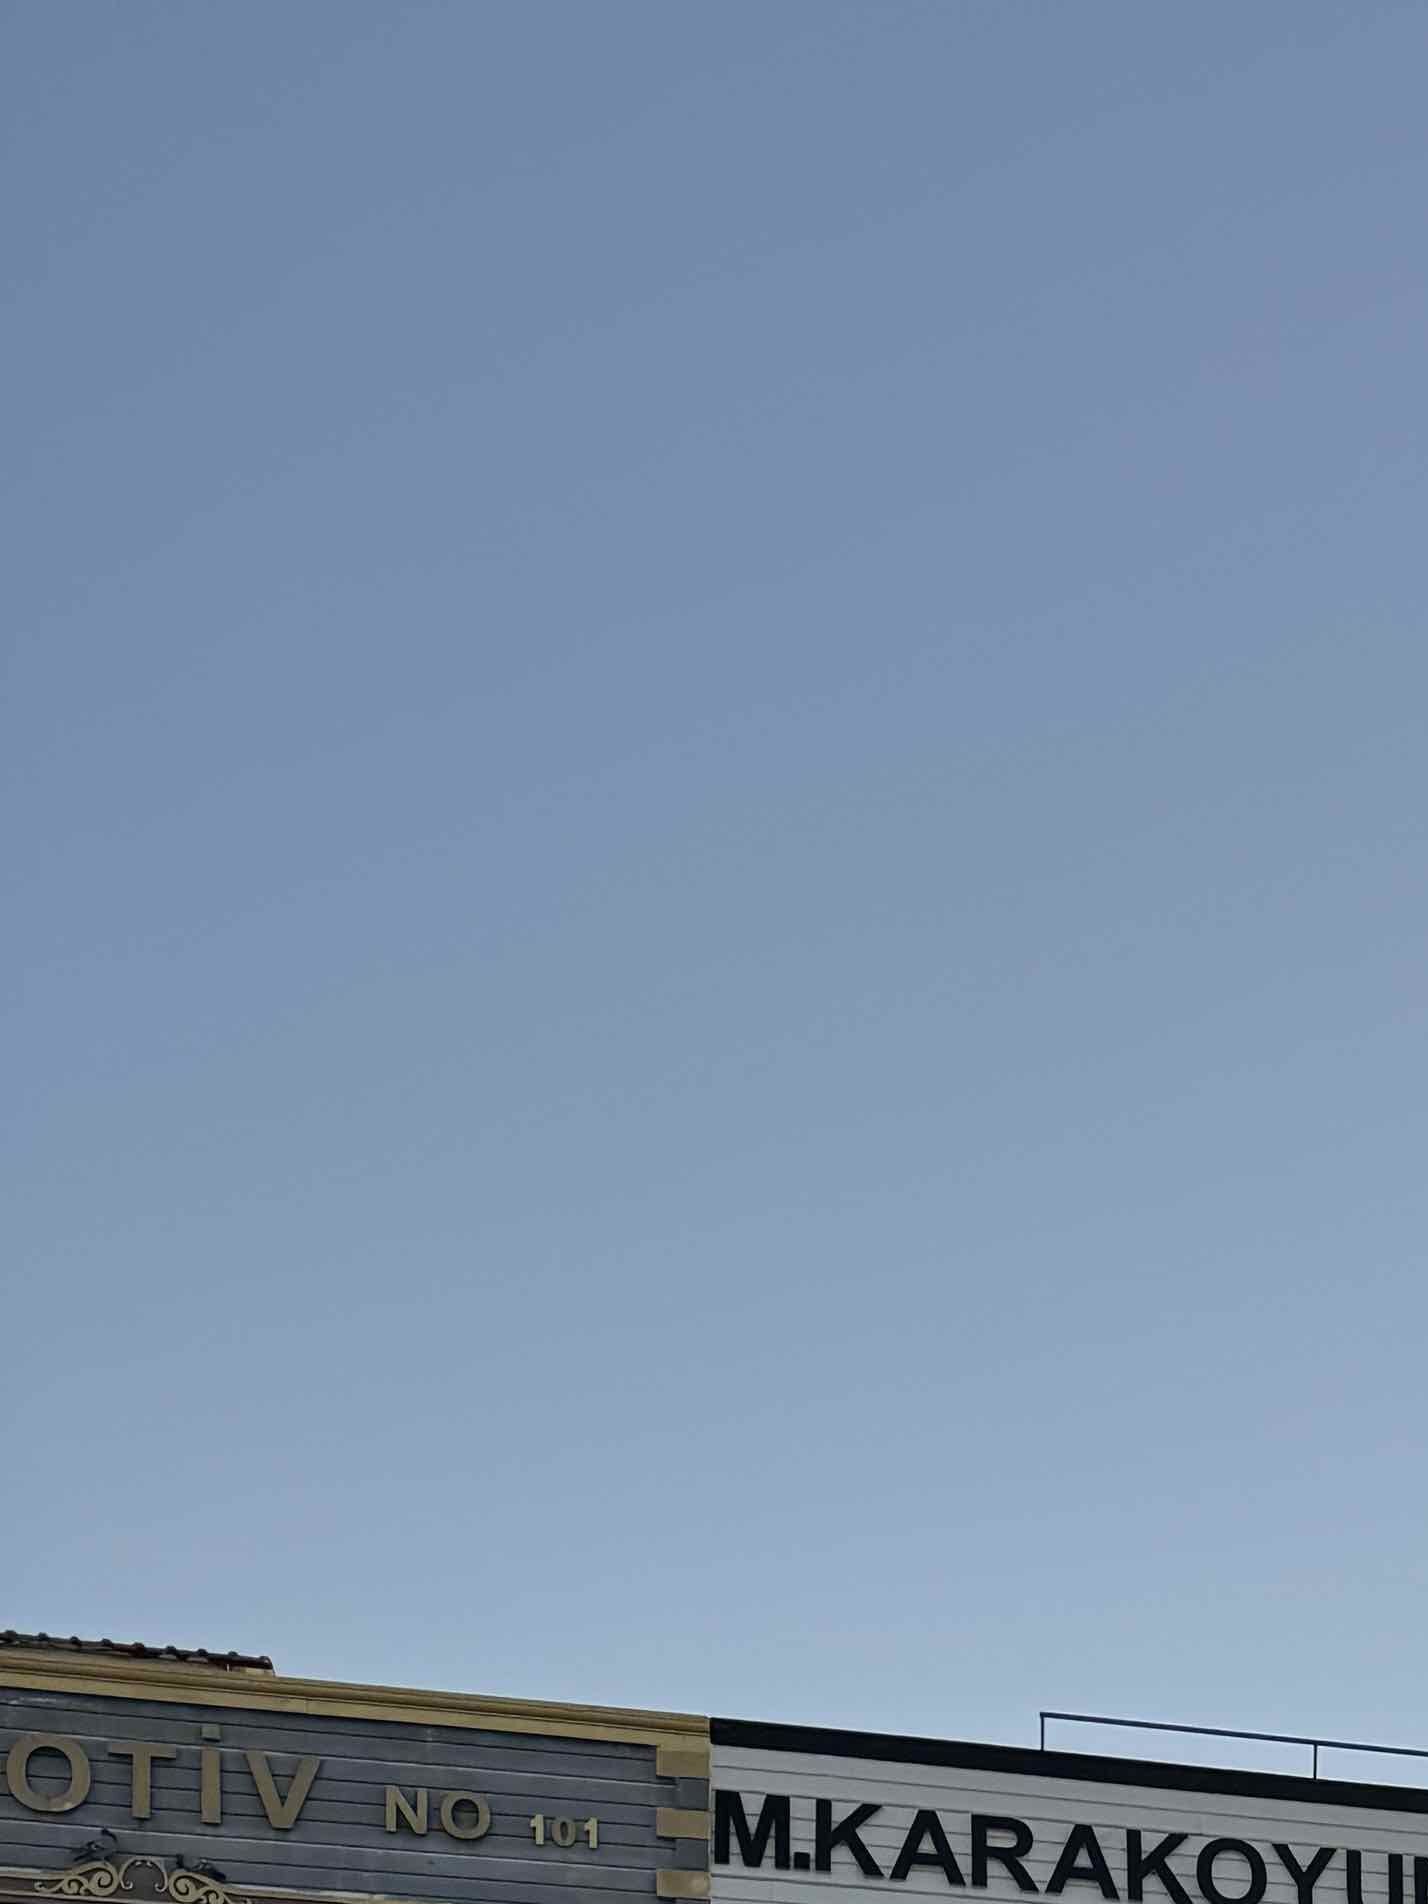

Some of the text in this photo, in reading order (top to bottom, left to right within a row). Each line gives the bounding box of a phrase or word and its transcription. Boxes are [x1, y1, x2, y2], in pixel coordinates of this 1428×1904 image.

[6, 1724, 599, 1849] OTİV NO 101
